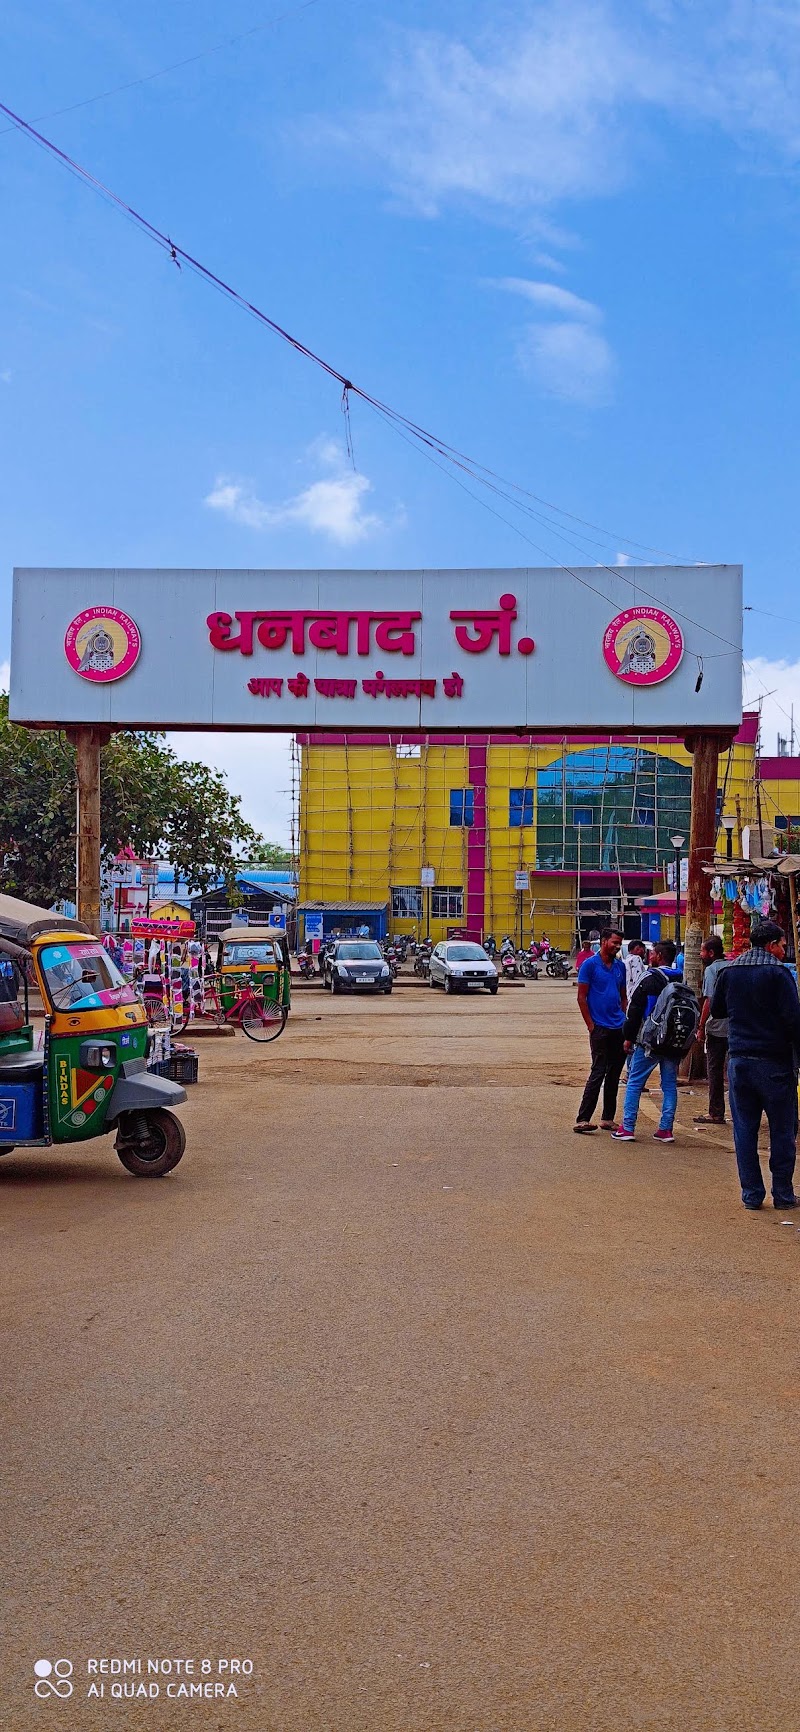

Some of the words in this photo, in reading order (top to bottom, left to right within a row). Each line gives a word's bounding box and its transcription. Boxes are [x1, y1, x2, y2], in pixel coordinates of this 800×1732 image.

[92, 607, 118, 616] INDIAN
[119, 613, 138, 648] RAILWAYS
[206, 611, 422, 656] धनबाद
[450, 593, 535, 656] जं.
[632, 608, 660, 616] INDIAN
[660, 614, 681, 649] RAILWAYS
[247, 677, 284, 698] आप
[442, 671, 464, 698] हो
[59, 1060, 69, 1105] BINDAS
